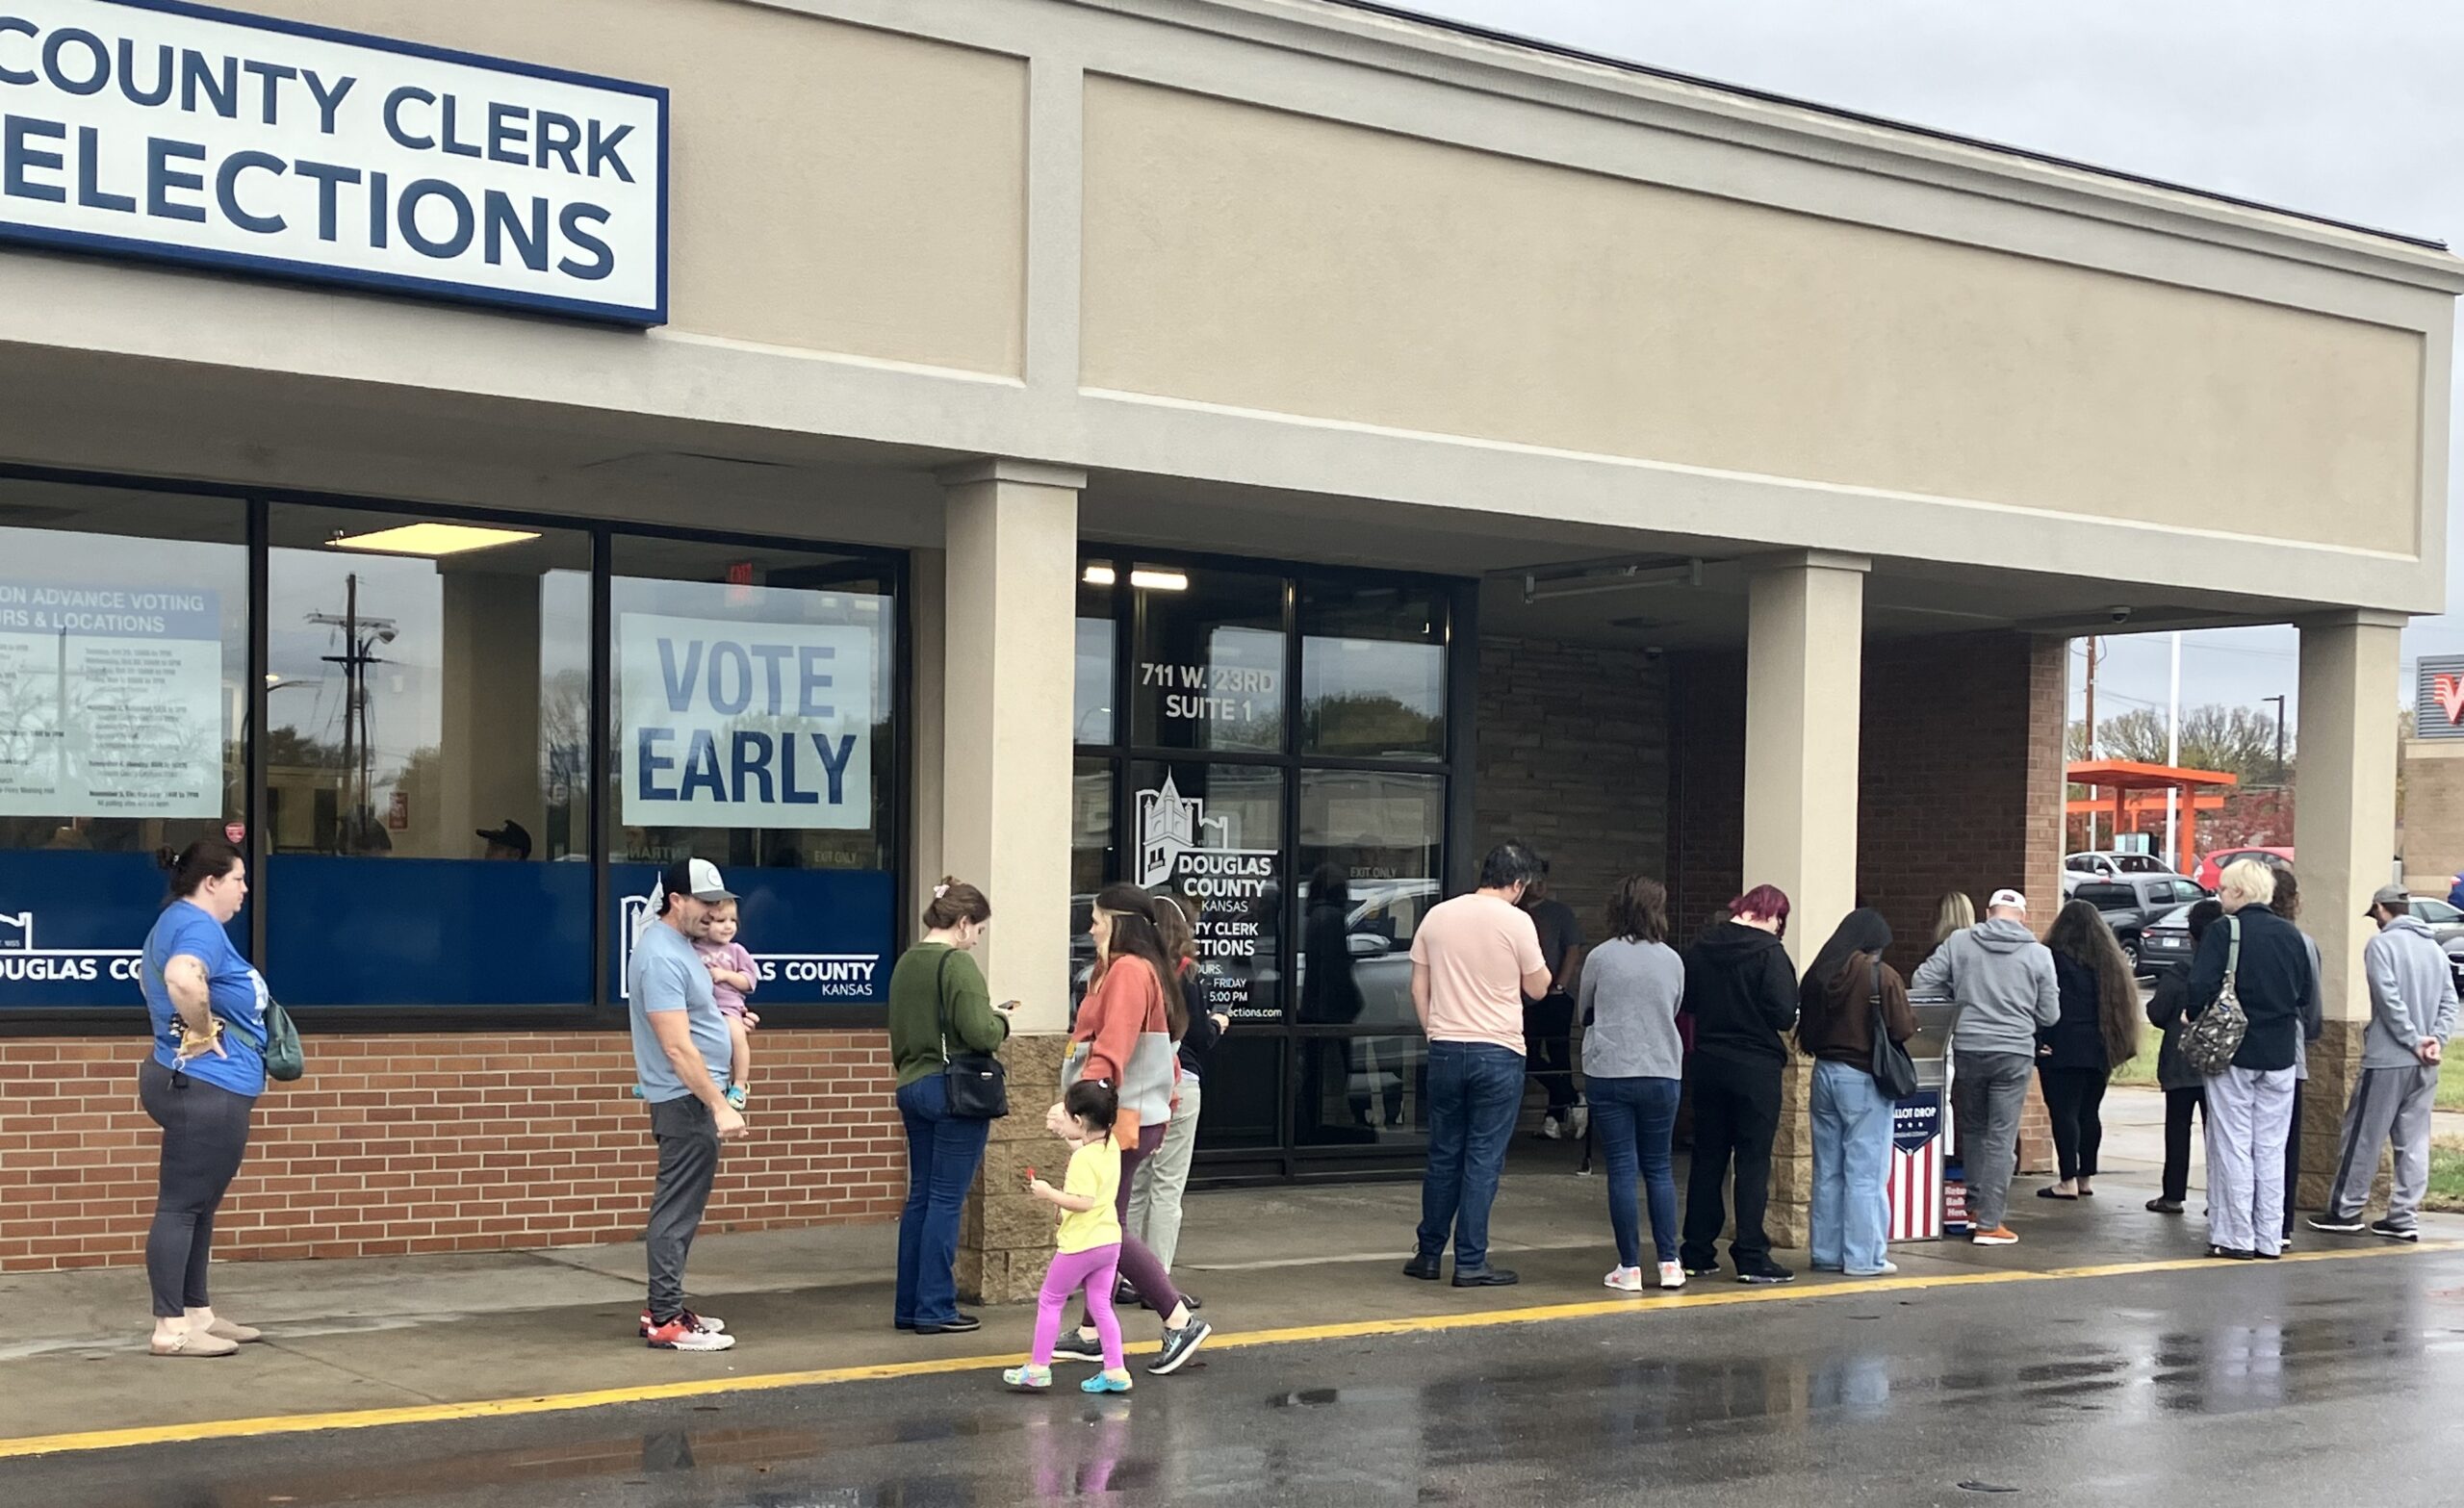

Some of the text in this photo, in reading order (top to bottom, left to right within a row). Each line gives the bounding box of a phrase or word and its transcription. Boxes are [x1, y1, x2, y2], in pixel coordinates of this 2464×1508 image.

[0, 16, 635, 183] COUNTY CLERK
[4, 115, 615, 280] ELECTIONS
[32, 588, 125, 608] ADVANCE
[130, 593, 205, 612] VOTING
[0, 609, 166, 633] RS & LOCATIONS
[656, 637, 835, 718] VOTE
[1141, 662, 1274, 693] 711 W. 23RD
[1166, 694, 1252, 722] SUITE 1
[638, 727, 857, 805] EARLY
[1178, 855, 1271, 876] DOUGLAS
[1349, 866, 1398, 879] EXIT ONLY
[1183, 878, 1267, 897] COUNTY
[1201, 900, 1249, 912] KANSAS
[1215, 921, 1259, 936] CLERK
[0, 958, 97, 981] UGLAS
[784, 961, 876, 981] COUNTY
[822, 984, 873, 996] KANSAS
[1213, 977, 1247, 988] FRIDAY
[1209, 991, 1248, 1002] 5:00 PM
